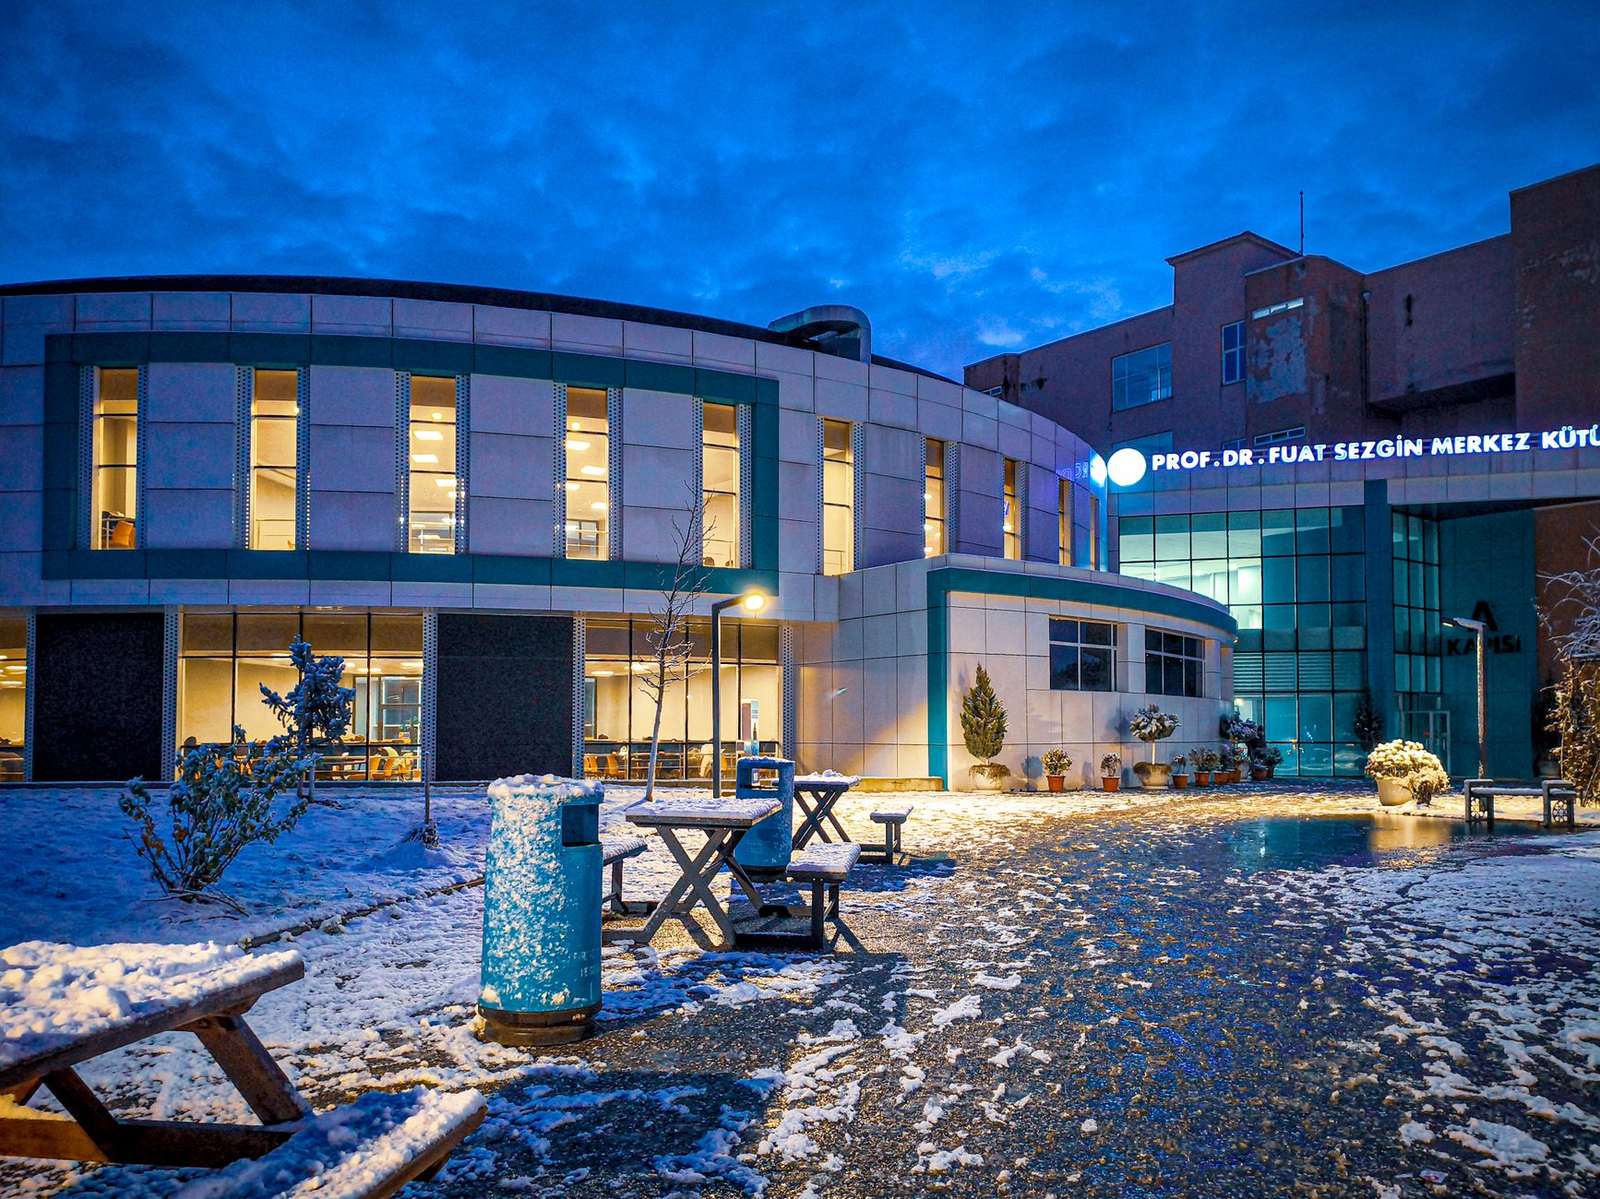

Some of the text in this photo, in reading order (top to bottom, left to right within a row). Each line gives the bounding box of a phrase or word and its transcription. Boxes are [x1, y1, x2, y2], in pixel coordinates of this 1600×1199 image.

[1334, 434, 1423, 460] SEZGİN
[1431, 432, 1530, 455] MERKEZ
[1468, 600, 1498, 631] A
